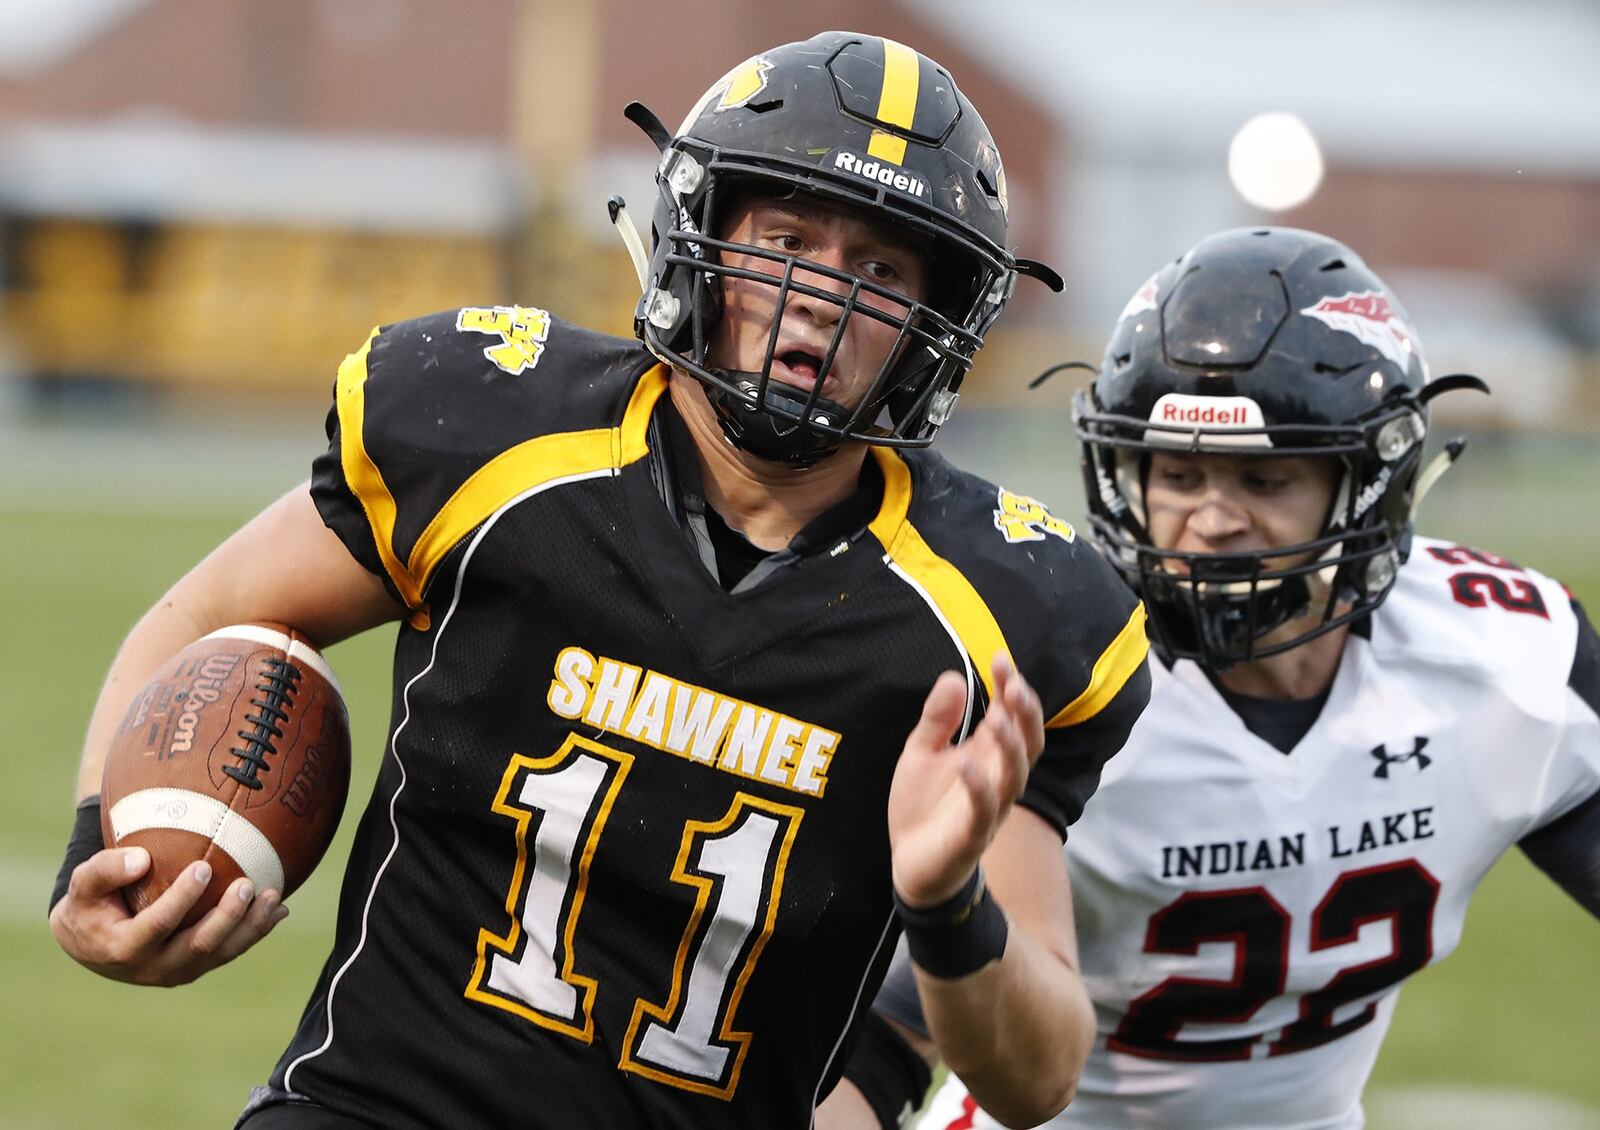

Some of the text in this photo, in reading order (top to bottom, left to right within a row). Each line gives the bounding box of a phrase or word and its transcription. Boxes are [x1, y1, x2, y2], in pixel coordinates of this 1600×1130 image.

[834, 150, 925, 198] Riddell
[1163, 403, 1247, 424] Riddell
[171, 654, 243, 753] Wilson
[547, 647, 842, 798] SHAWNEE
[1162, 806, 1435, 878] INDIAN LAKE
[464, 732, 805, 1101] 11
[1105, 857, 1441, 1064] 22
